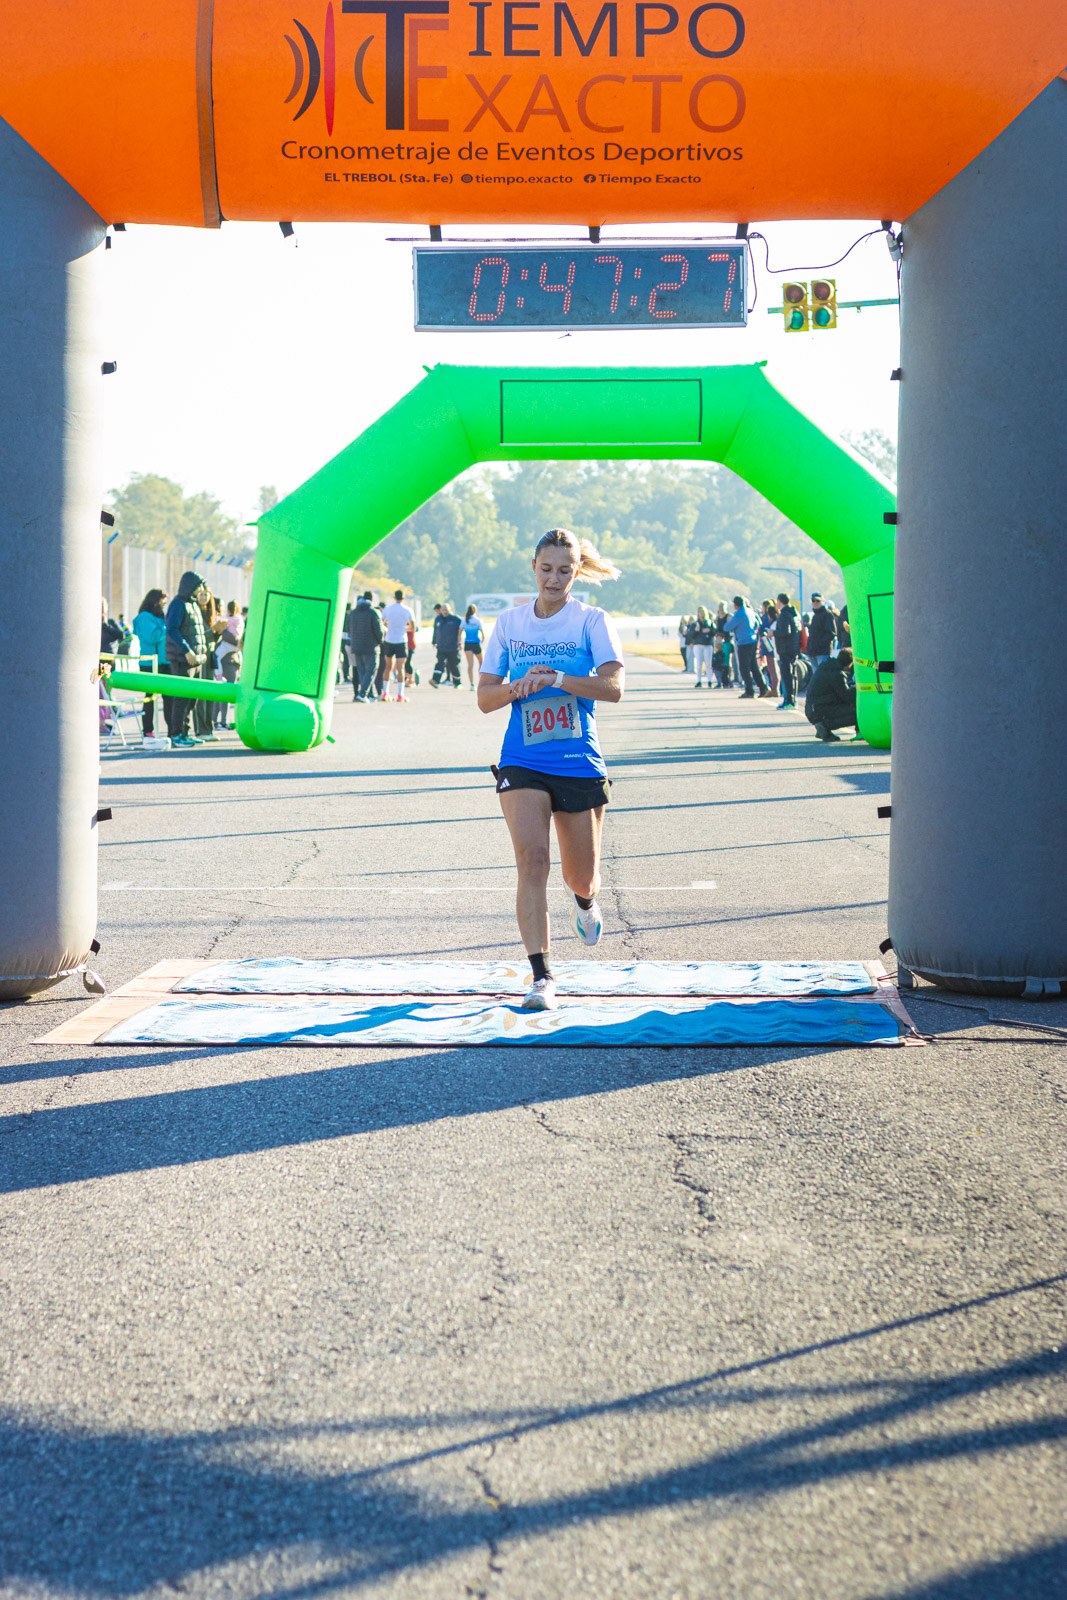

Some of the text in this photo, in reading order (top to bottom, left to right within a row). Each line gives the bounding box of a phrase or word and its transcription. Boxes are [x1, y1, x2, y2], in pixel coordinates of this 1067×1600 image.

[281, 141, 743, 165] Cronometraje de Eventos Deportivos
[324, 172, 453, 184] EL TREBOL (Sta. Fe)
[475, 173, 573, 186] tiempo.exacto
[599, 173, 702, 185] Tiempo Exacto
[469, 253, 737, 321] 0:47:27
[531, 705, 570, 734] 204
